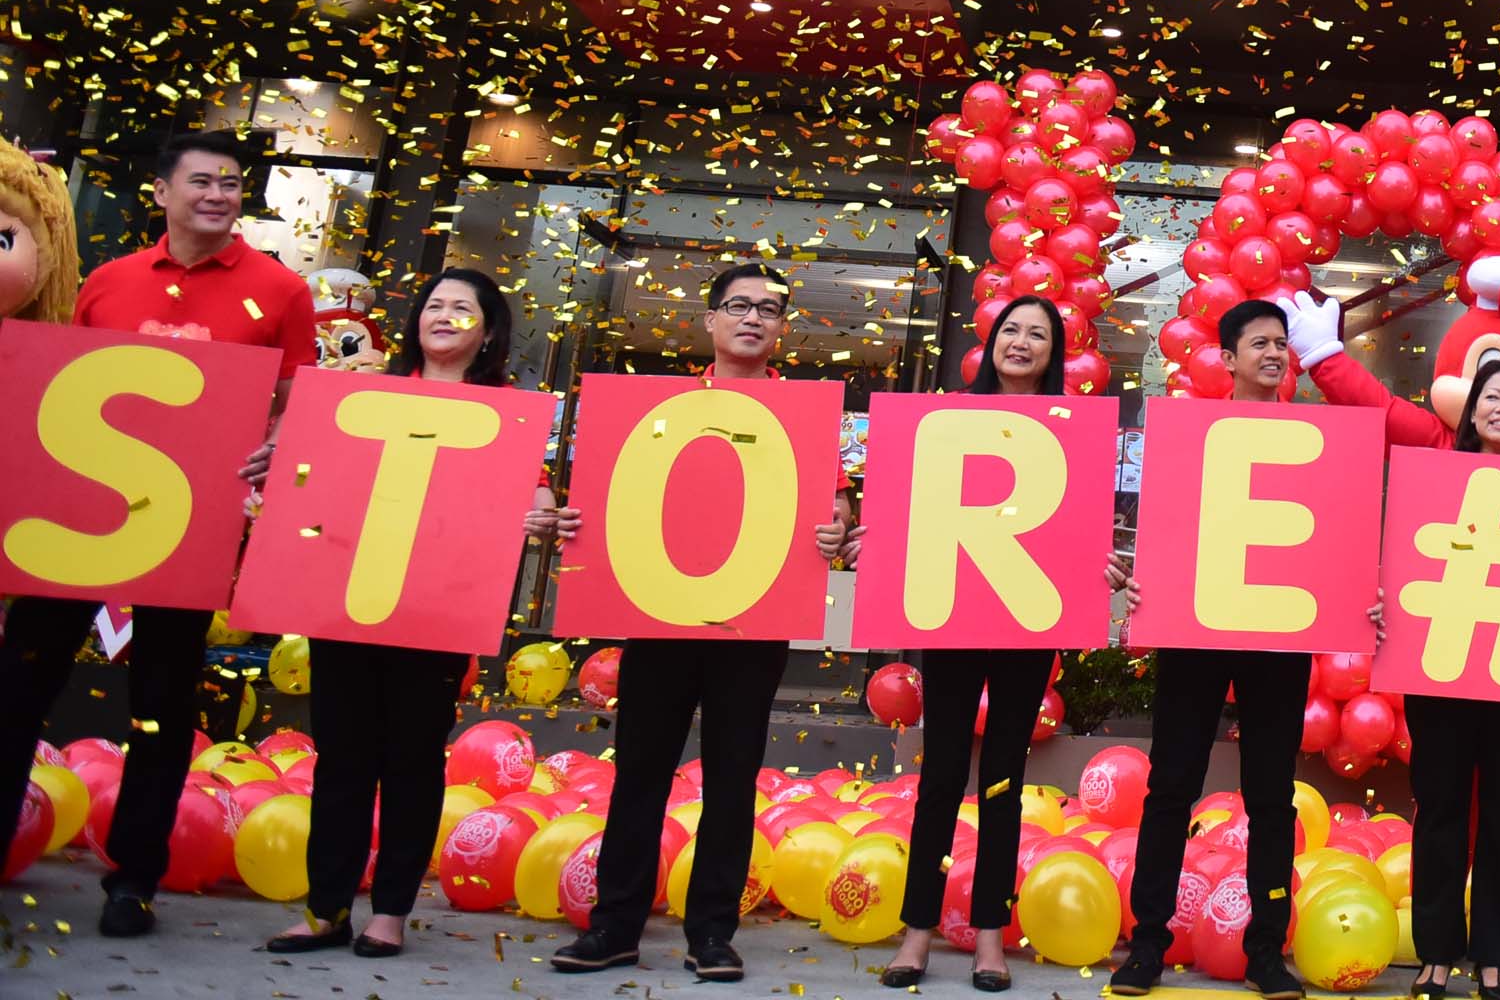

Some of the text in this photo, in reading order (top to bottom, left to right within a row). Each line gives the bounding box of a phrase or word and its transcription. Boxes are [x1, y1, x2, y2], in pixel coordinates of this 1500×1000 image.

[1083, 780, 1107, 791] 1000
[461, 822, 493, 838] 1000
[839, 875, 864, 909] 1000
[1177, 878, 1199, 922] 1000
[1221, 886, 1247, 911] 1000
